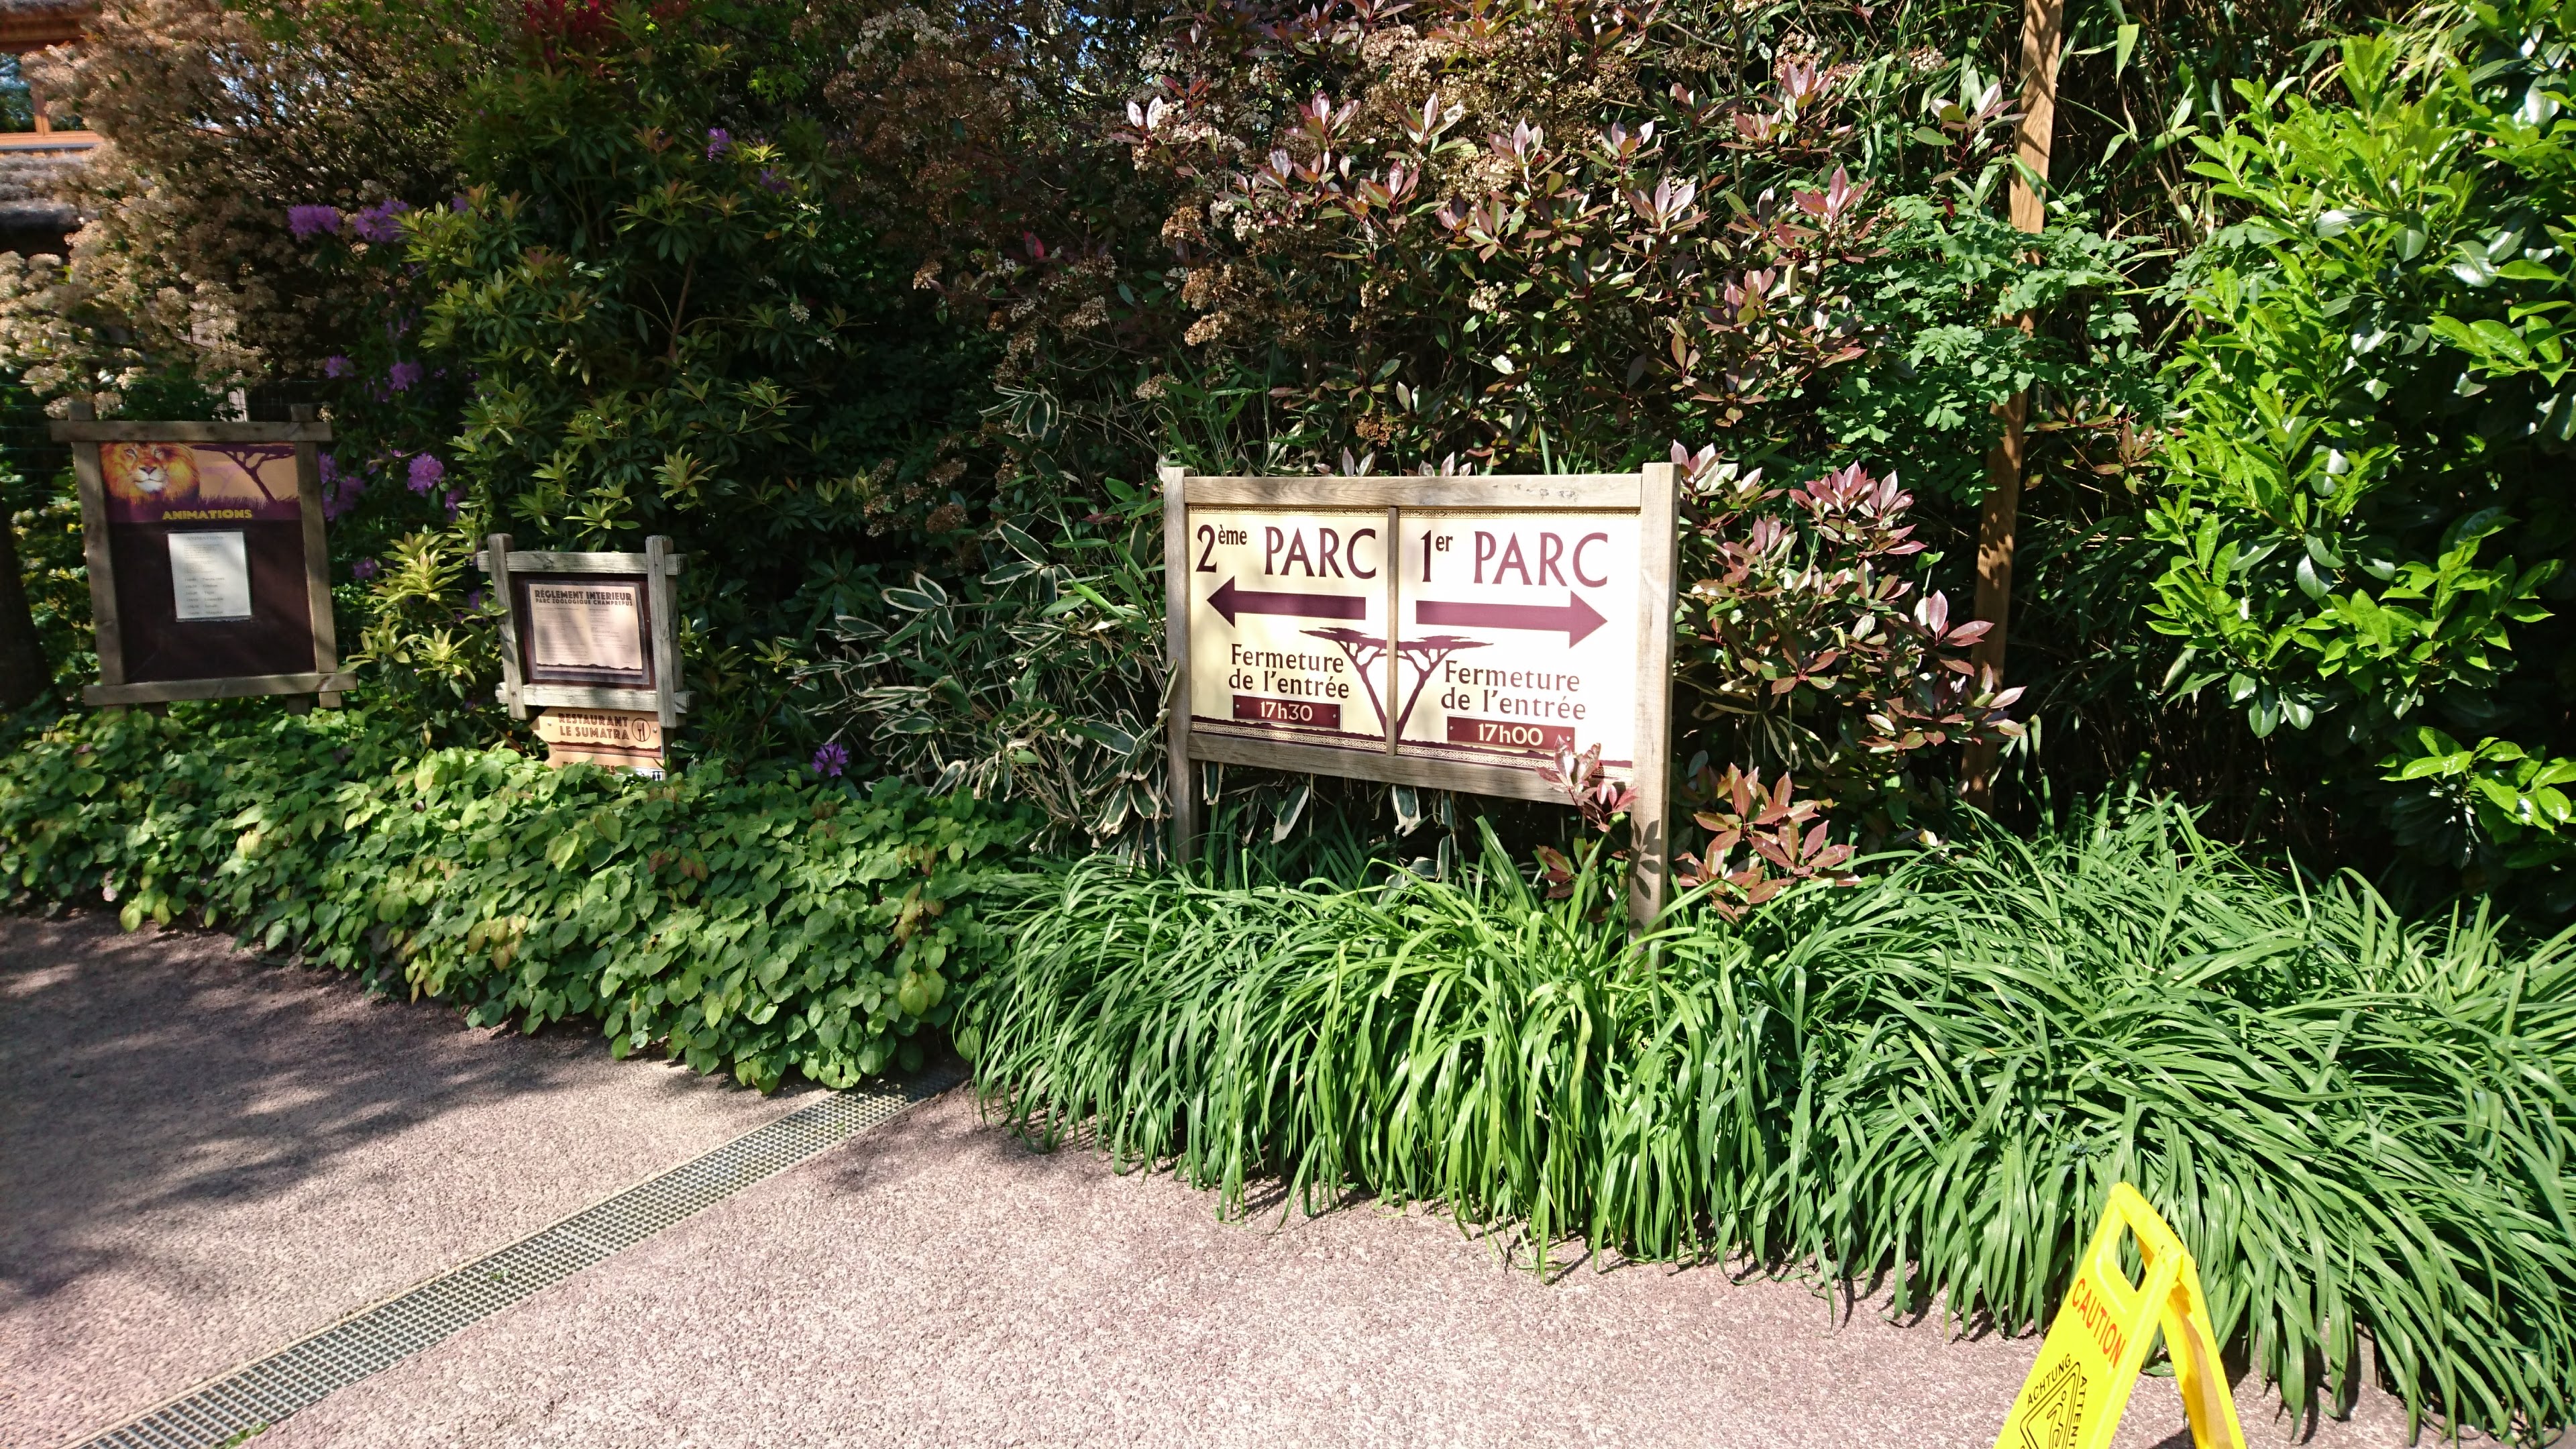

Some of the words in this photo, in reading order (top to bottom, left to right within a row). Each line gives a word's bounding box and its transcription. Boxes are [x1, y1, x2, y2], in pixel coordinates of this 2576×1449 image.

[162, 509, 252, 520] ANIMATIONS
[1195, 524, 1248, 574] 2ème
[1265, 526, 1377, 580] PARC
[1420, 529, 1454, 582] 1er
[1473, 531, 1609, 588] PARC
[586, 591, 632, 601] INTERIEUR
[1231, 643, 1344, 674] Fermeture
[1228, 668, 1253, 690] de
[1264, 670, 1349, 699] l'entrée
[1445, 659, 1580, 692] Fermeture
[1260, 701, 1313, 722] 17h30
[1441, 686, 1470, 710] de
[1483, 689, 1586, 720] l'entrée
[558, 712, 629, 727] RESTAURANT
[559, 725, 572, 737] LE
[575, 727, 630, 740] SUMATRA
[1478, 723, 1544, 746] 17h00
[2072, 1277, 2127, 1369] CAUTION
[2027, 1353, 2071, 1409] ACHTUNG
